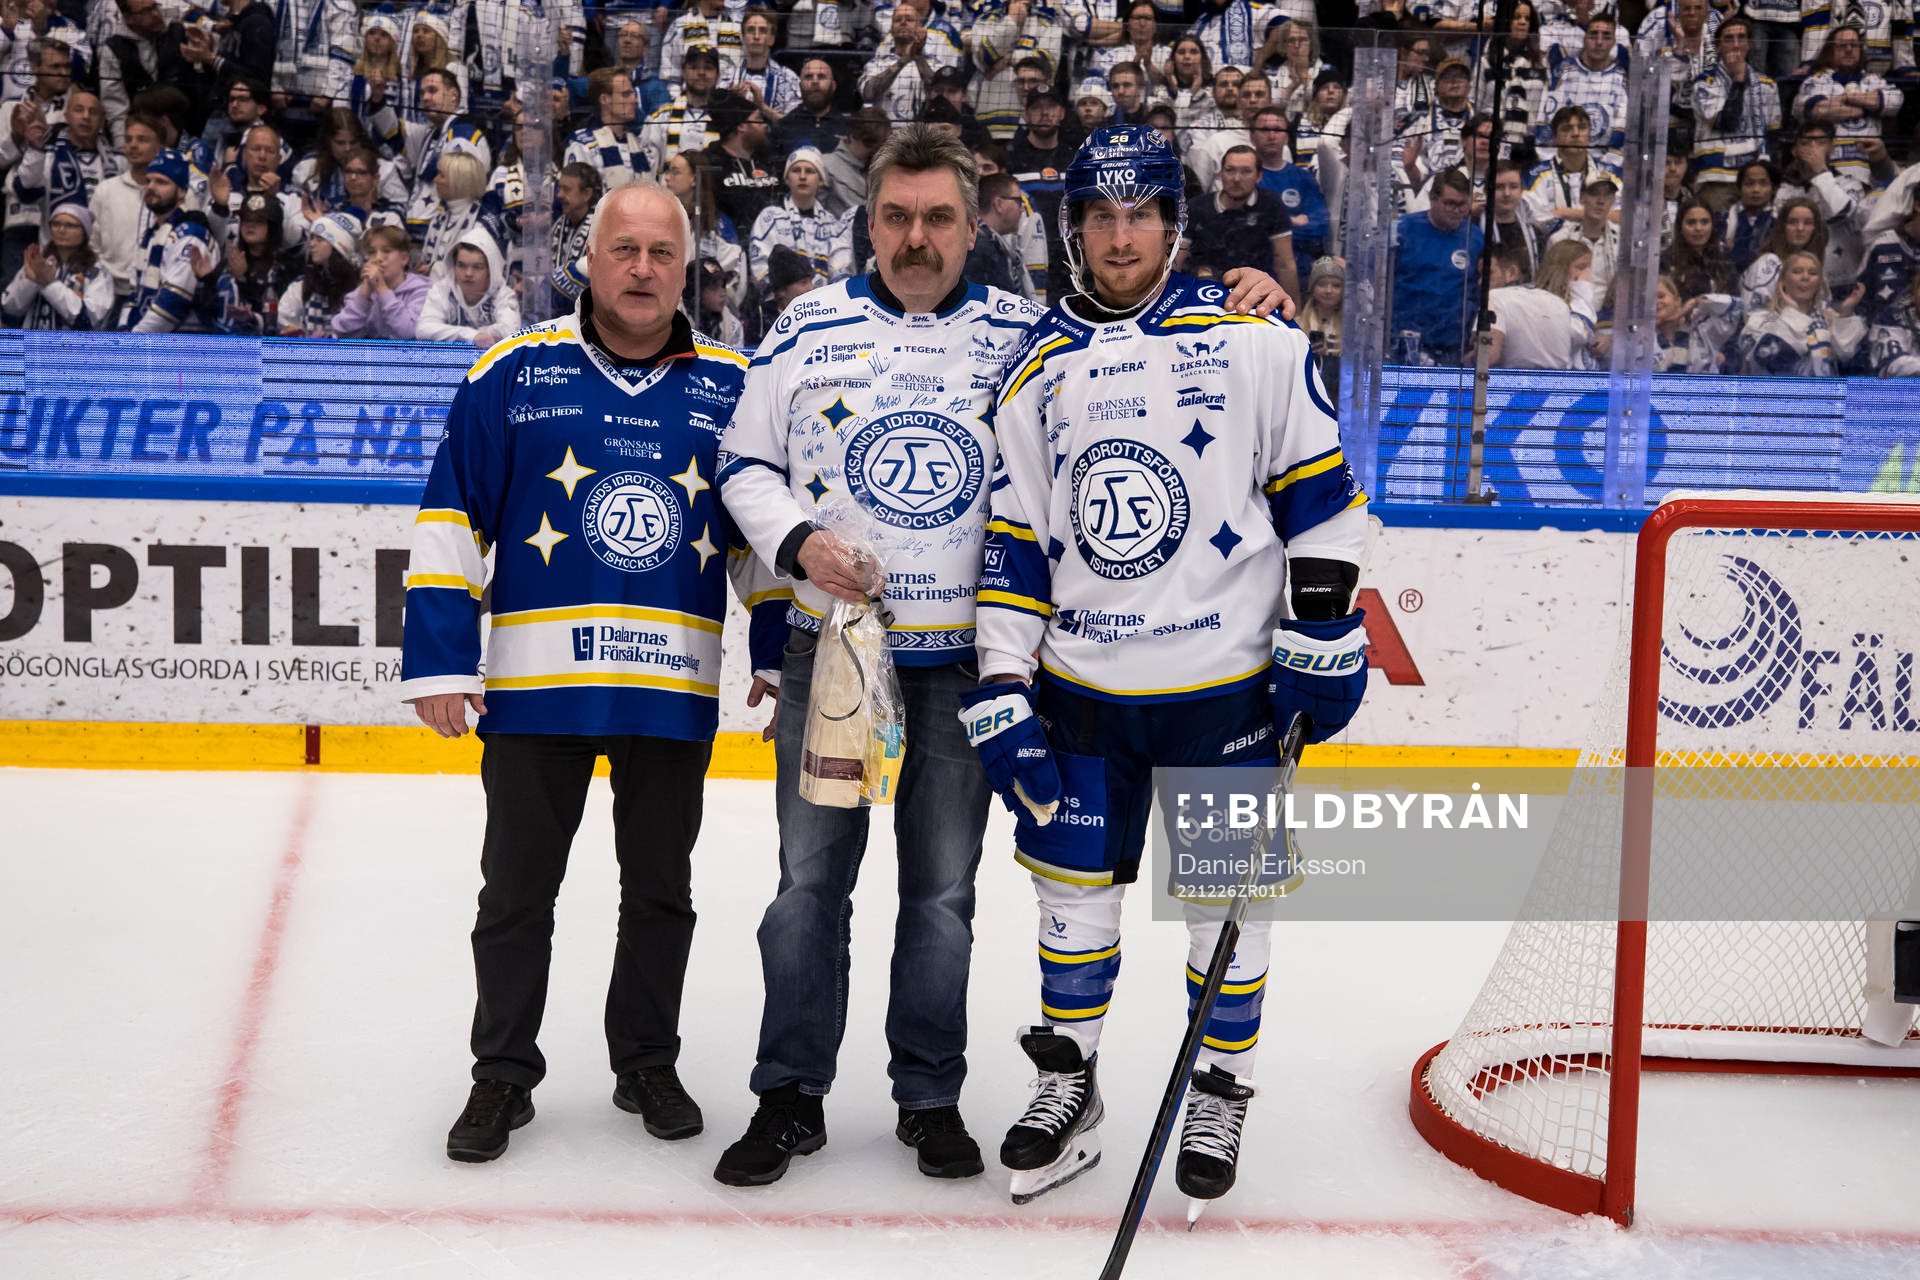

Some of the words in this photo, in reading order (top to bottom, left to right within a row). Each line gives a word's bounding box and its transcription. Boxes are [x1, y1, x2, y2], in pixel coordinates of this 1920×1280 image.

[1109, 135, 1129, 144] 28
[723, 173, 779, 188] ellesse
[1096, 168, 1136, 186] LYKO
[793, 300, 821, 312] Clas
[1156, 287, 1185, 316] TEGERA
[794, 307, 837, 322] Ohlson
[869, 307, 895, 327] TEGERA
[951, 306, 974, 322] TEGERA
[1057, 319, 1085, 339] TEGERA
[1103, 324, 1127, 335] SHL
[831, 342, 875, 352] Bergkvist
[904, 346, 947, 354] TEGERA
[590, 347, 621, 381] TEGERA
[831, 352, 857, 362] Siljan
[620, 368, 644, 378] SHL
[1101, 361, 1147, 376] TEGERA
[1171, 358, 1230, 374] LEKSANDS
[844, 379, 872, 389] HEDIN
[891, 373, 944, 384] GRÖNSAKS
[685, 387, 736, 403] LEKSANDS
[905, 383, 937, 392] HUSET
[1176, 393, 1226, 408] dalakraft
[515, 414, 526, 423] AB
[527, 410, 550, 421] KARL
[552, 408, 583, 417] HEDIN
[615, 416, 659, 428] TEGERA
[1100, 408, 1138, 421] HUSET
[604, 437, 661, 451] GRÖNSAKS
[620, 448, 654, 458] HUSET
[885, 414, 982, 501] IDROTTSFÖRENING
[1087, 441, 1188, 540] IDROTTSFÖRENING
[585, 482, 612, 545] LEKSANDS
[611, 475, 680, 550] IDROTTSFÖRENING
[872, 504, 957, 528] ISHOCKEY
[602, 550, 661, 570] ISHOCKEY
[1090, 548, 1166, 578] ISHOCKEY
[599, 625, 668, 647] Dalarnas
[1272, 643, 1366, 671] BAUER
[150, 657, 248, 682] GJORDA
[1222, 722, 1274, 755] BAUER
